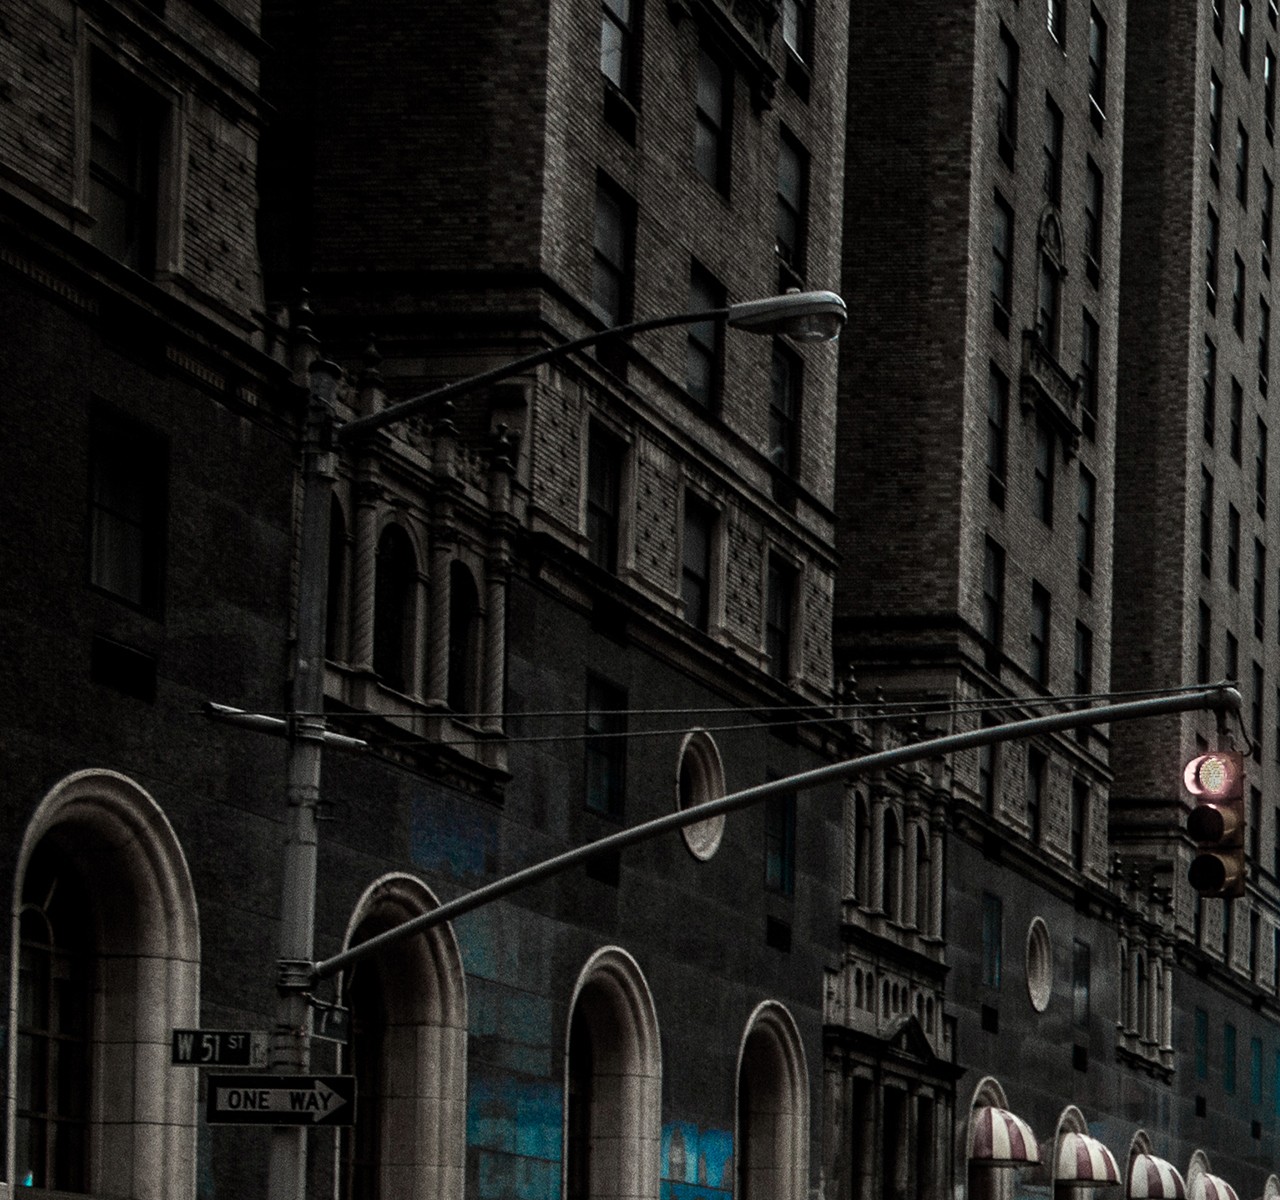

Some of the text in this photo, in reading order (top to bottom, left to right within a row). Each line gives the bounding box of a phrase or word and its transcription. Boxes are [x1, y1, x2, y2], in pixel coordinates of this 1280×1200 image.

[177, 1033, 246, 1063] W 51 ST
[228, 1090, 334, 1110] ONE WAY
